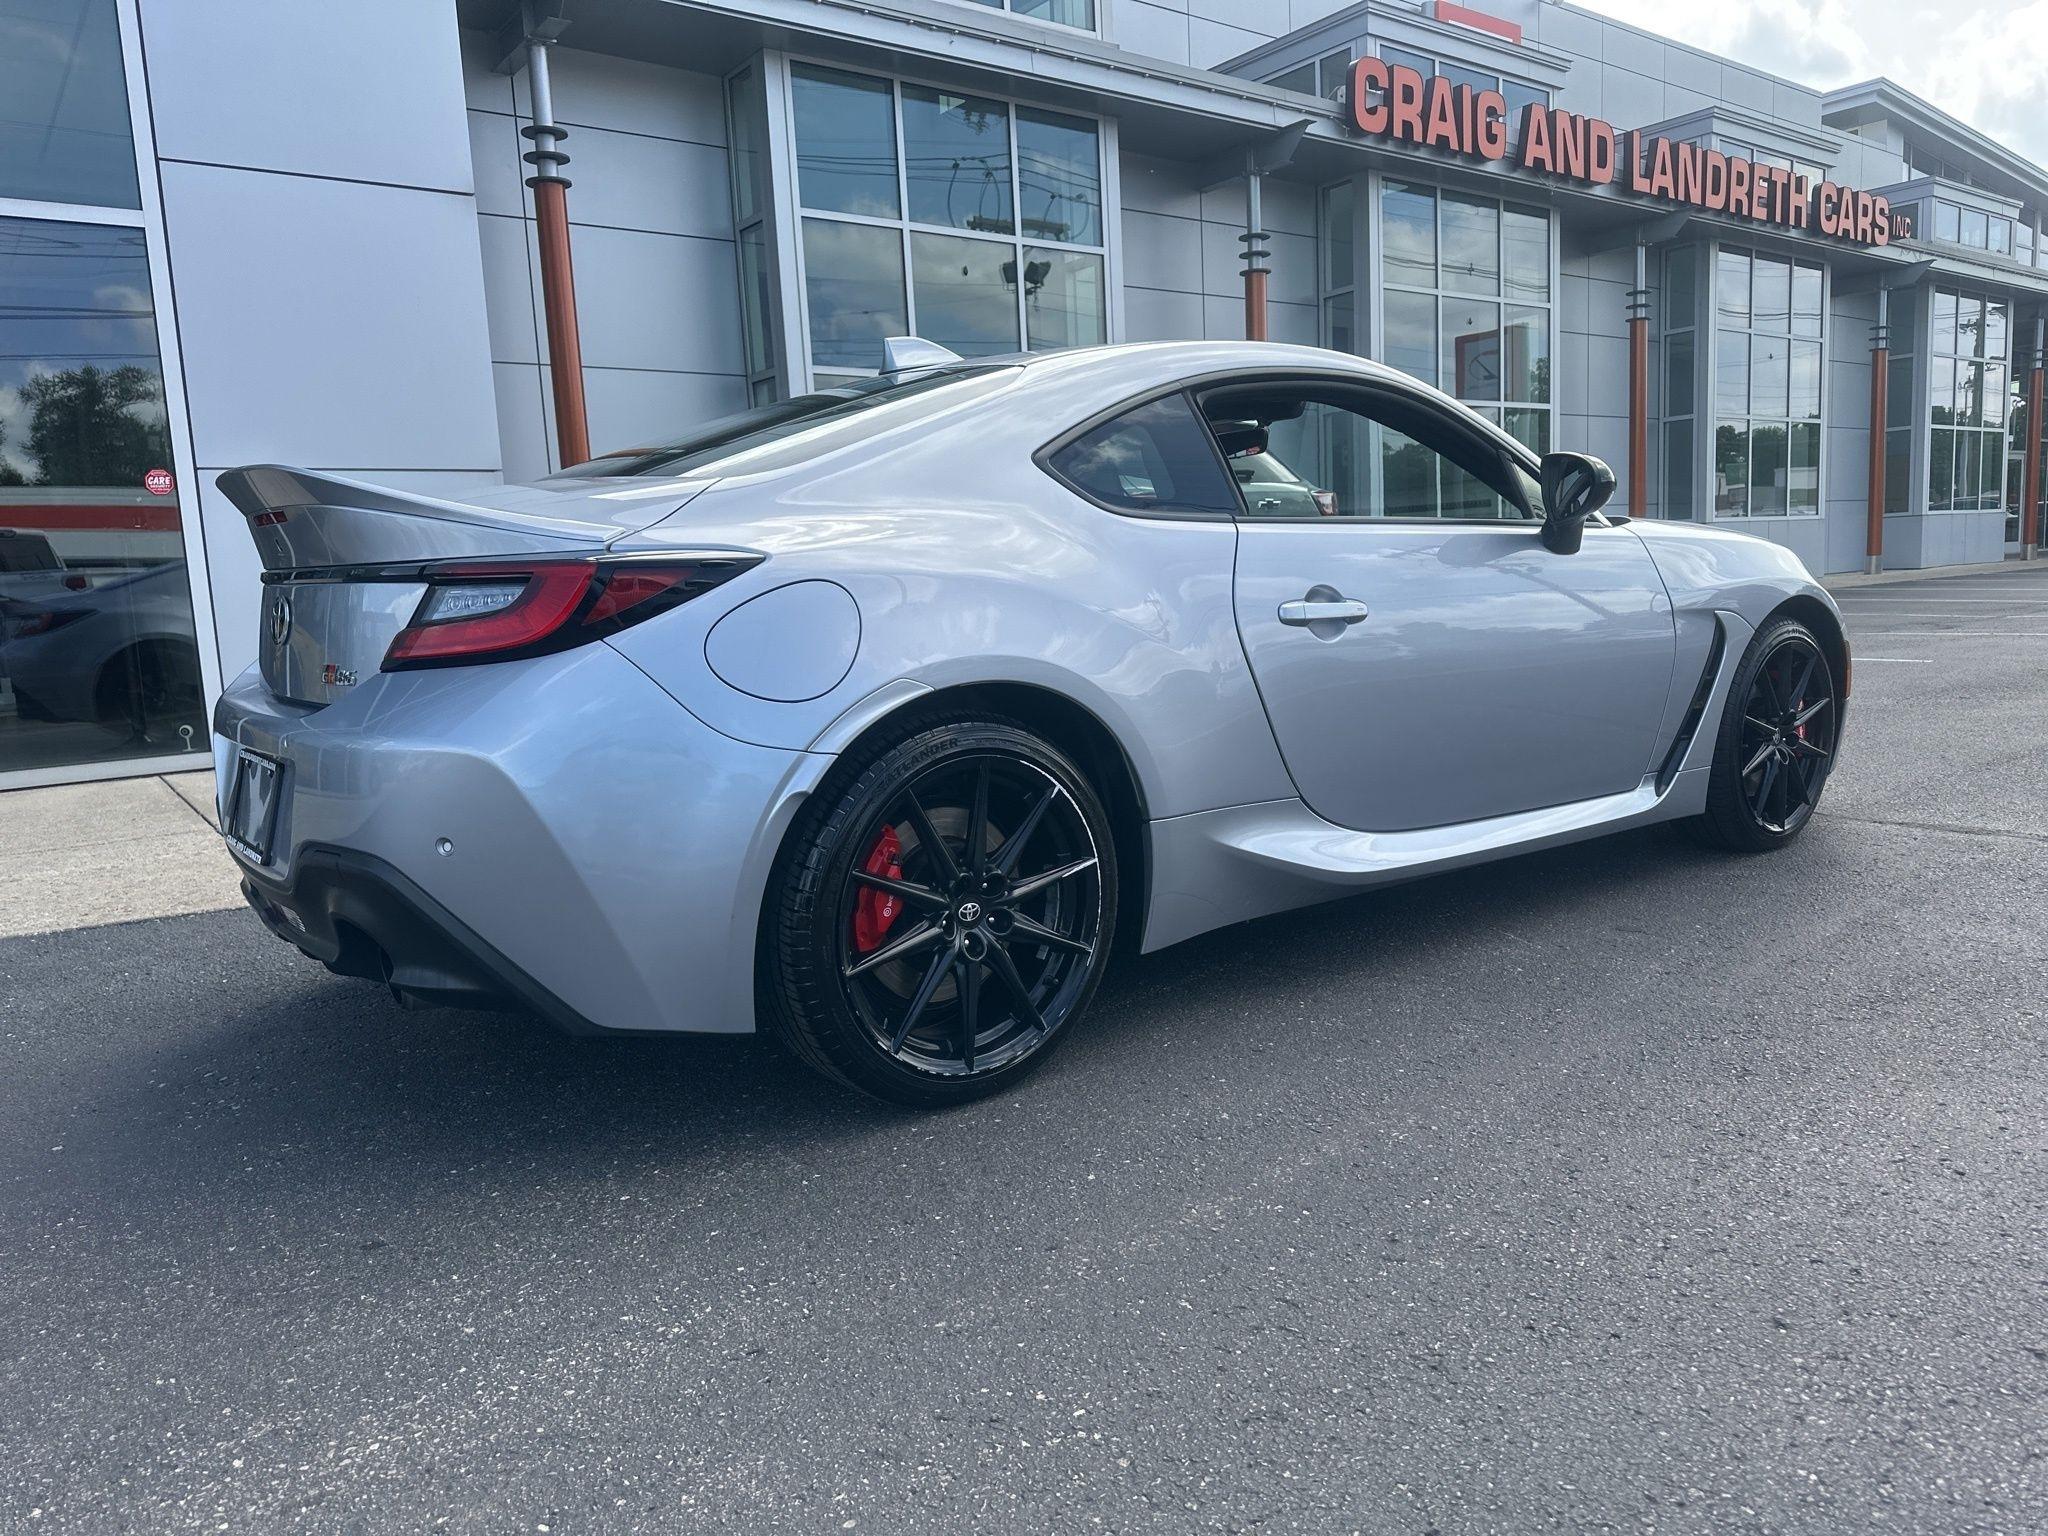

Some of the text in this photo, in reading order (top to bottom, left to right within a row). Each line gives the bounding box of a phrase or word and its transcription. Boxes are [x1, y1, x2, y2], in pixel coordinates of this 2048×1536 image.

[1350, 56, 1911, 246] CRAIG AND LANDRETH CARS INC
[148, 476, 170, 485] CARE
